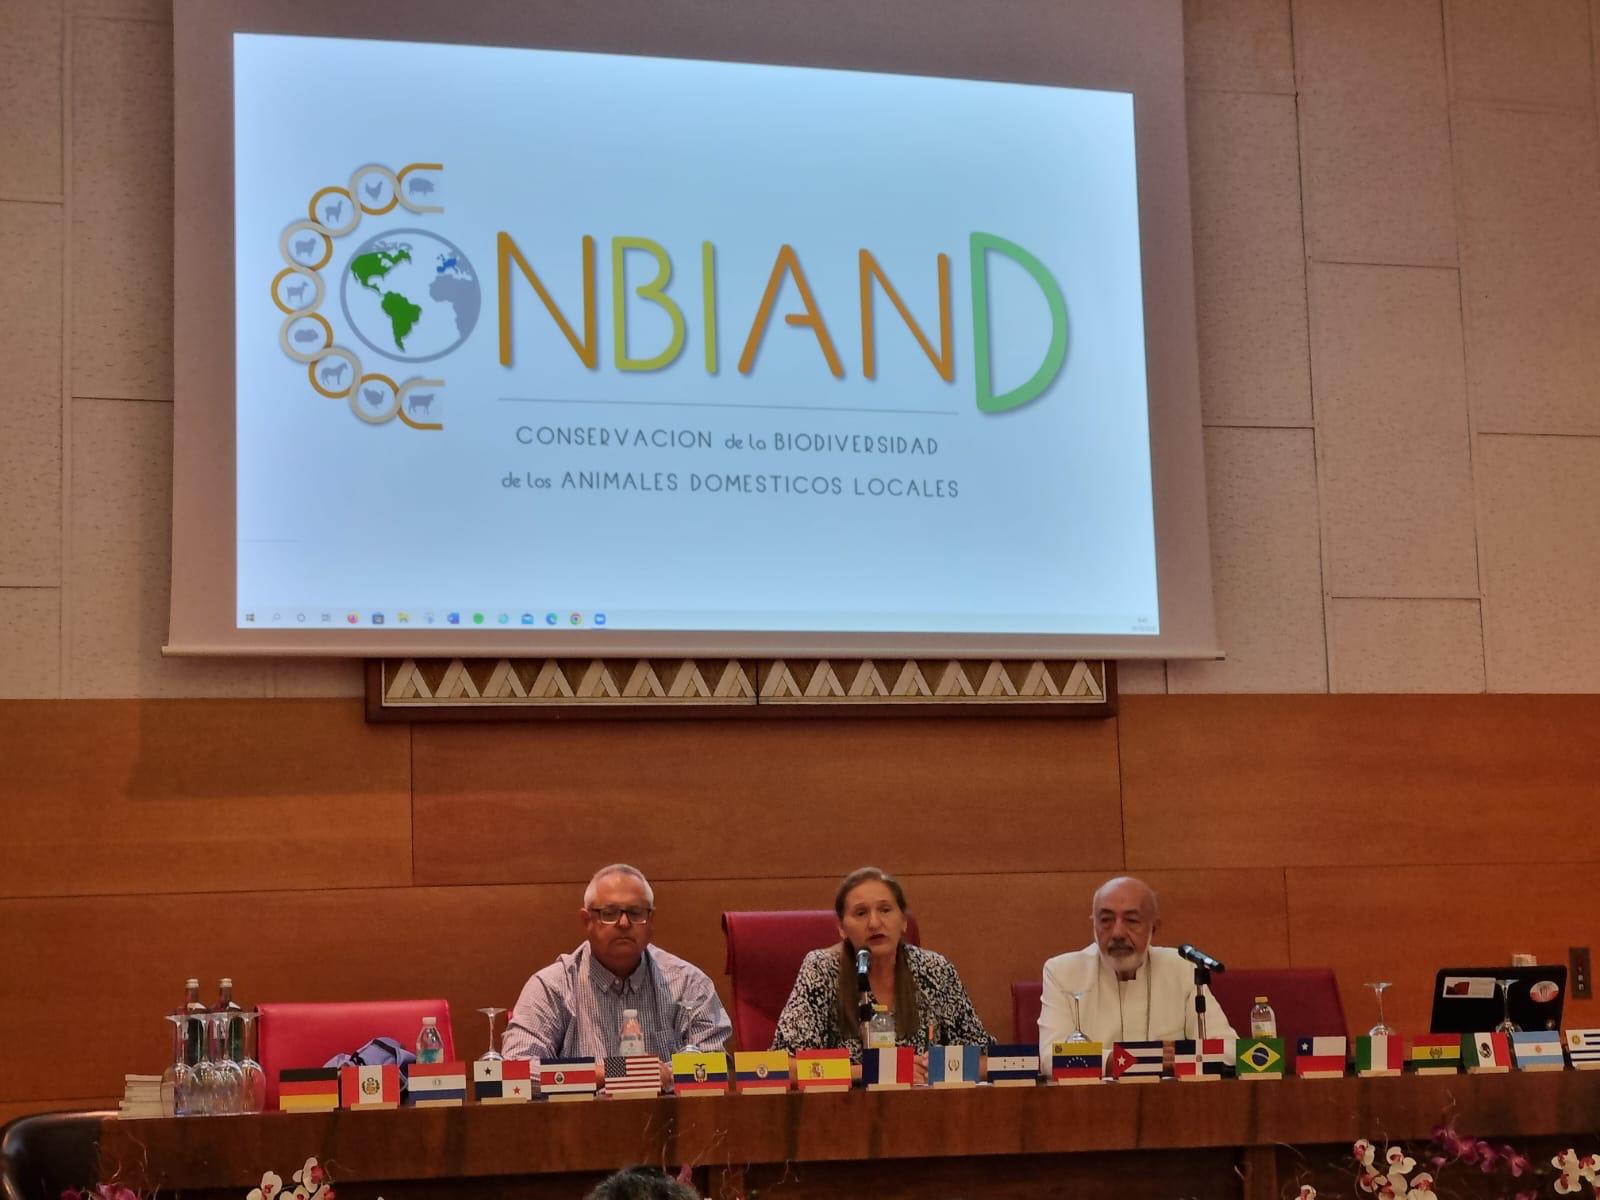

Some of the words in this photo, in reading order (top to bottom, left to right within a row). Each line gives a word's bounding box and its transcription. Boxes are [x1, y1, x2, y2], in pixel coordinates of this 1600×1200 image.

[515, 425, 712, 449] CONSERVACION
[723, 432, 744, 451] de
[747, 432, 768, 451] la
[773, 431, 939, 456] BIODIVERSIDAD
[500, 471, 521, 489] de
[526, 471, 552, 489] los
[560, 470, 679, 492] ANIMALES
[689, 473, 843, 496] DOMESTICOS
[853, 476, 959, 499] LOCALES
